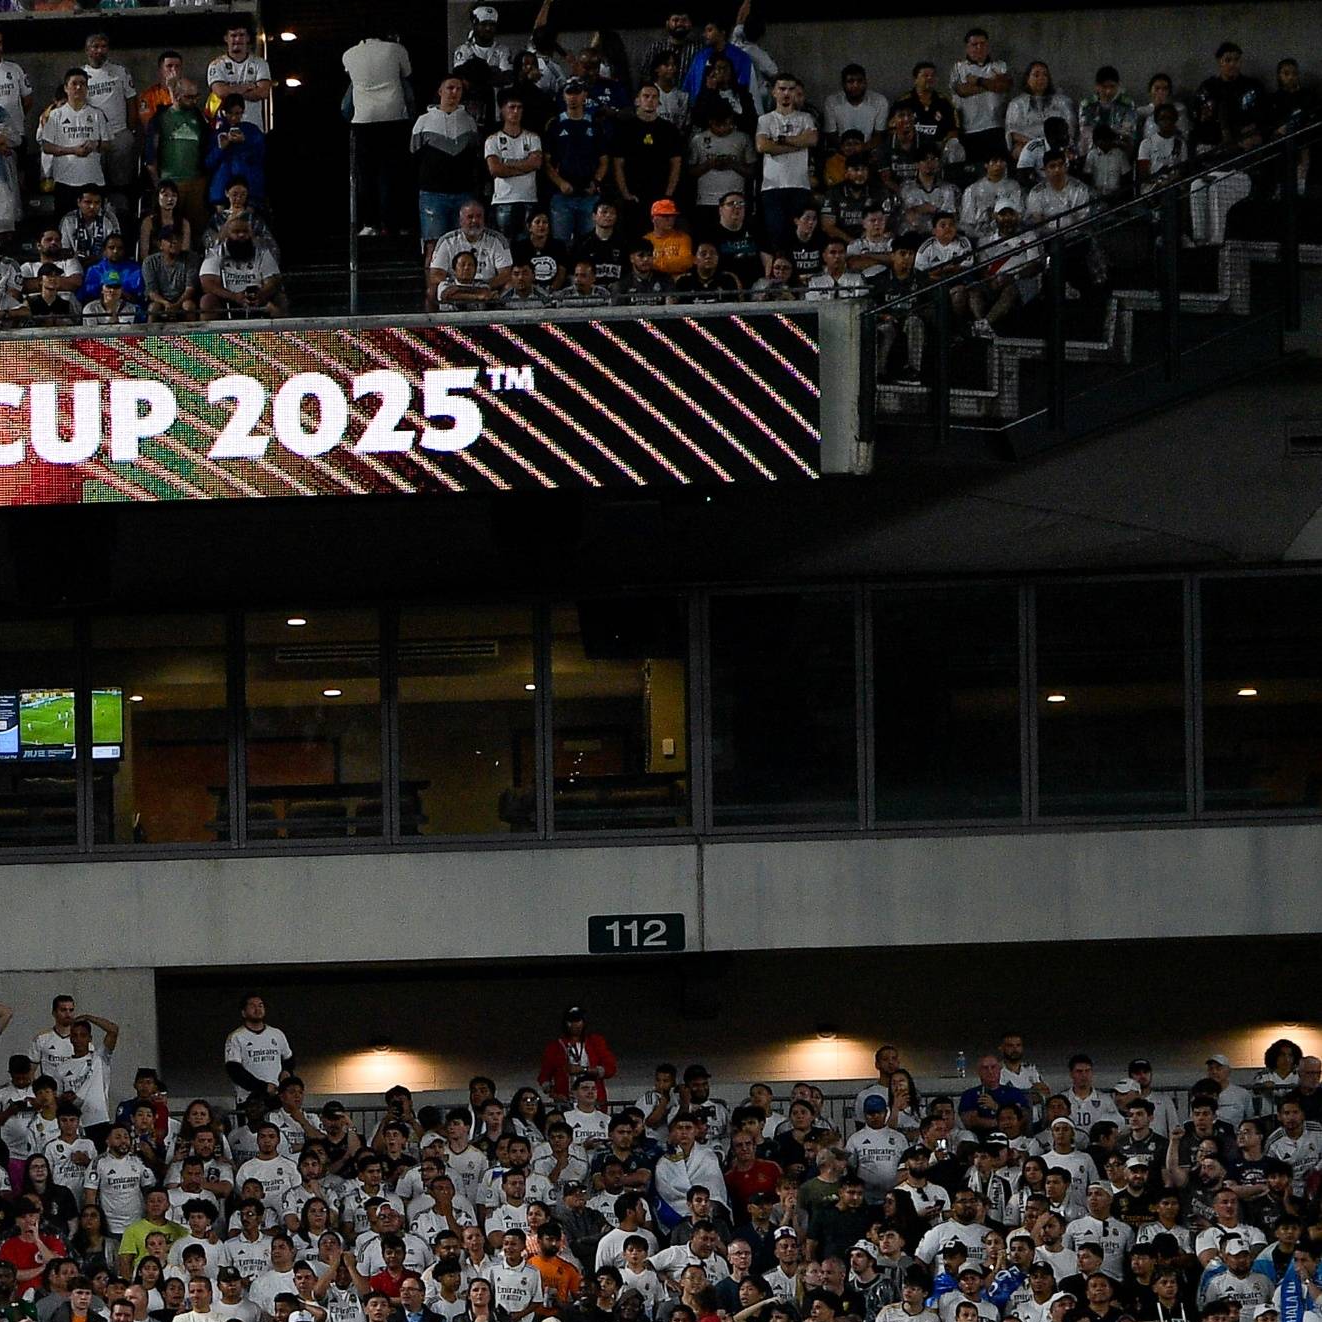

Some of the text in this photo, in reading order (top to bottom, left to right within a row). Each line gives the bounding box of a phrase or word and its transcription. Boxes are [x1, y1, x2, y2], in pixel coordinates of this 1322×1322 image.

[603, 919, 667, 948] 112
[248, 1048, 279, 1057] Emirates
[1077, 1112, 1090, 1126] 10
[863, 1147, 895, 1155] Emirates
[107, 1177, 139, 1185] Emirates
